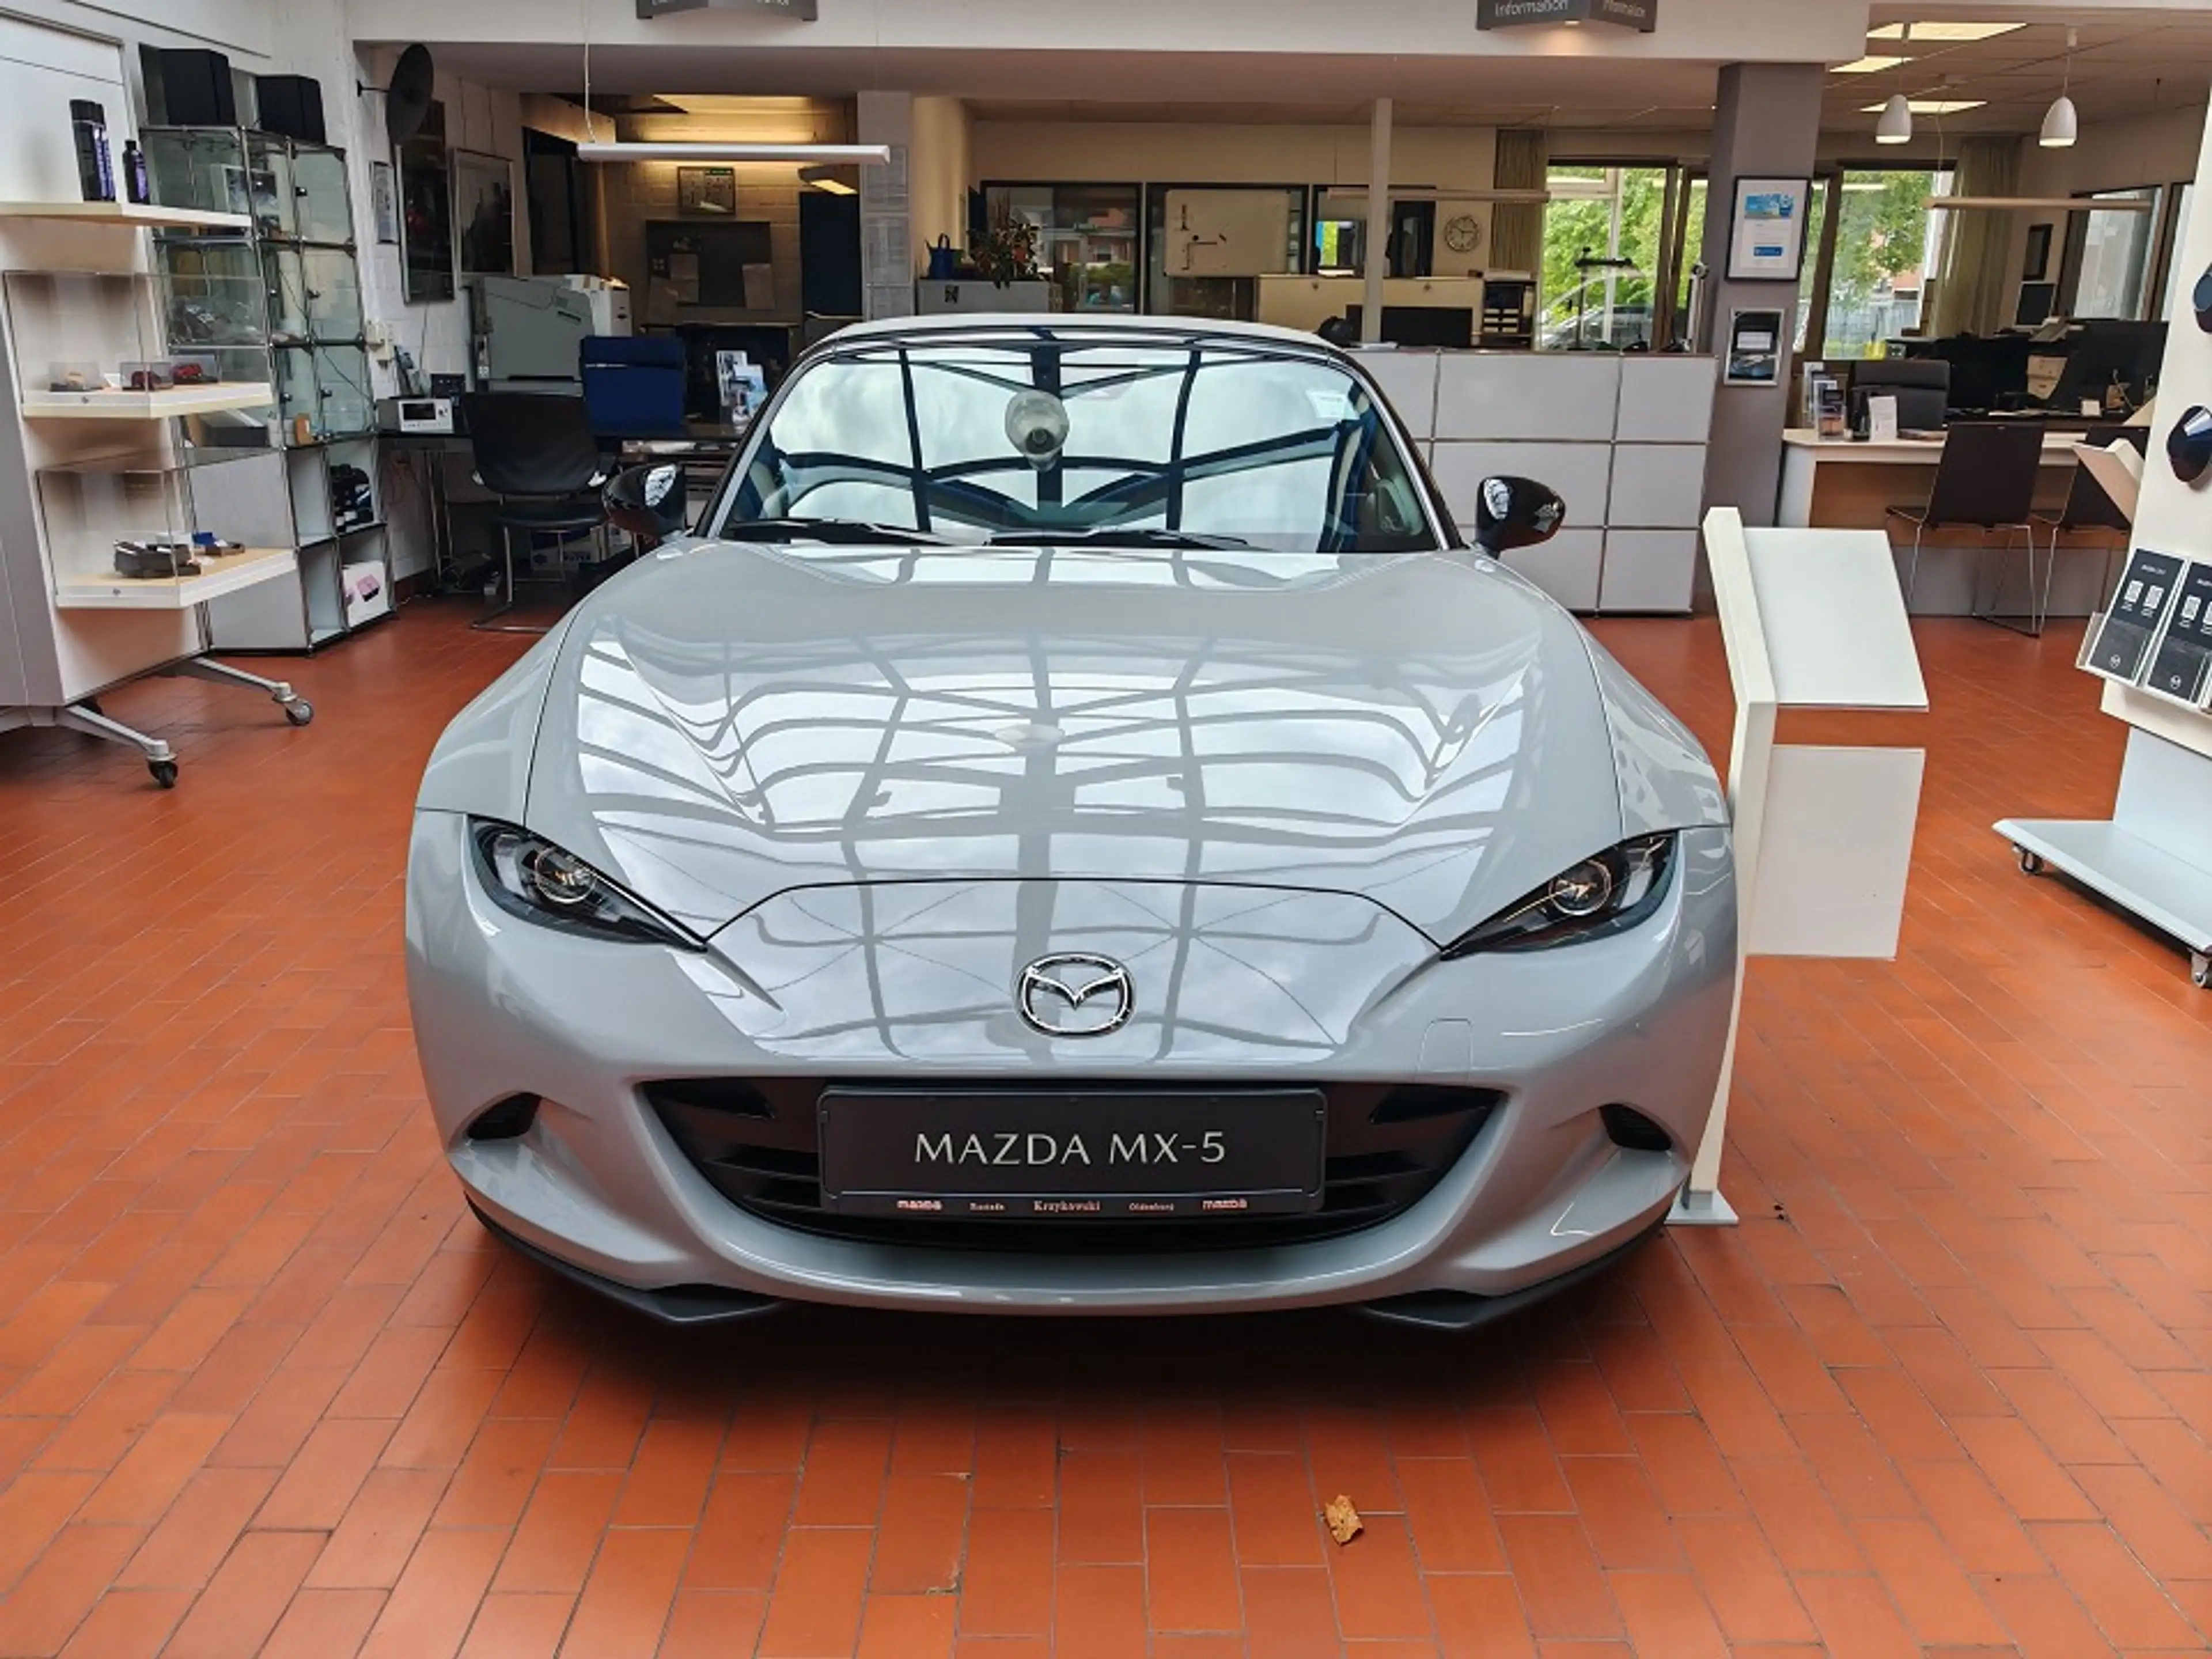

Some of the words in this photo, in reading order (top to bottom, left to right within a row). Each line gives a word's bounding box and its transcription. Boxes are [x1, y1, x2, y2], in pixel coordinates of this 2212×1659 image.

[1495, 0, 1568, 17] Information
[915, 1133, 1092, 1165] MAZDA
[1109, 1131, 1225, 1164] MX-5
